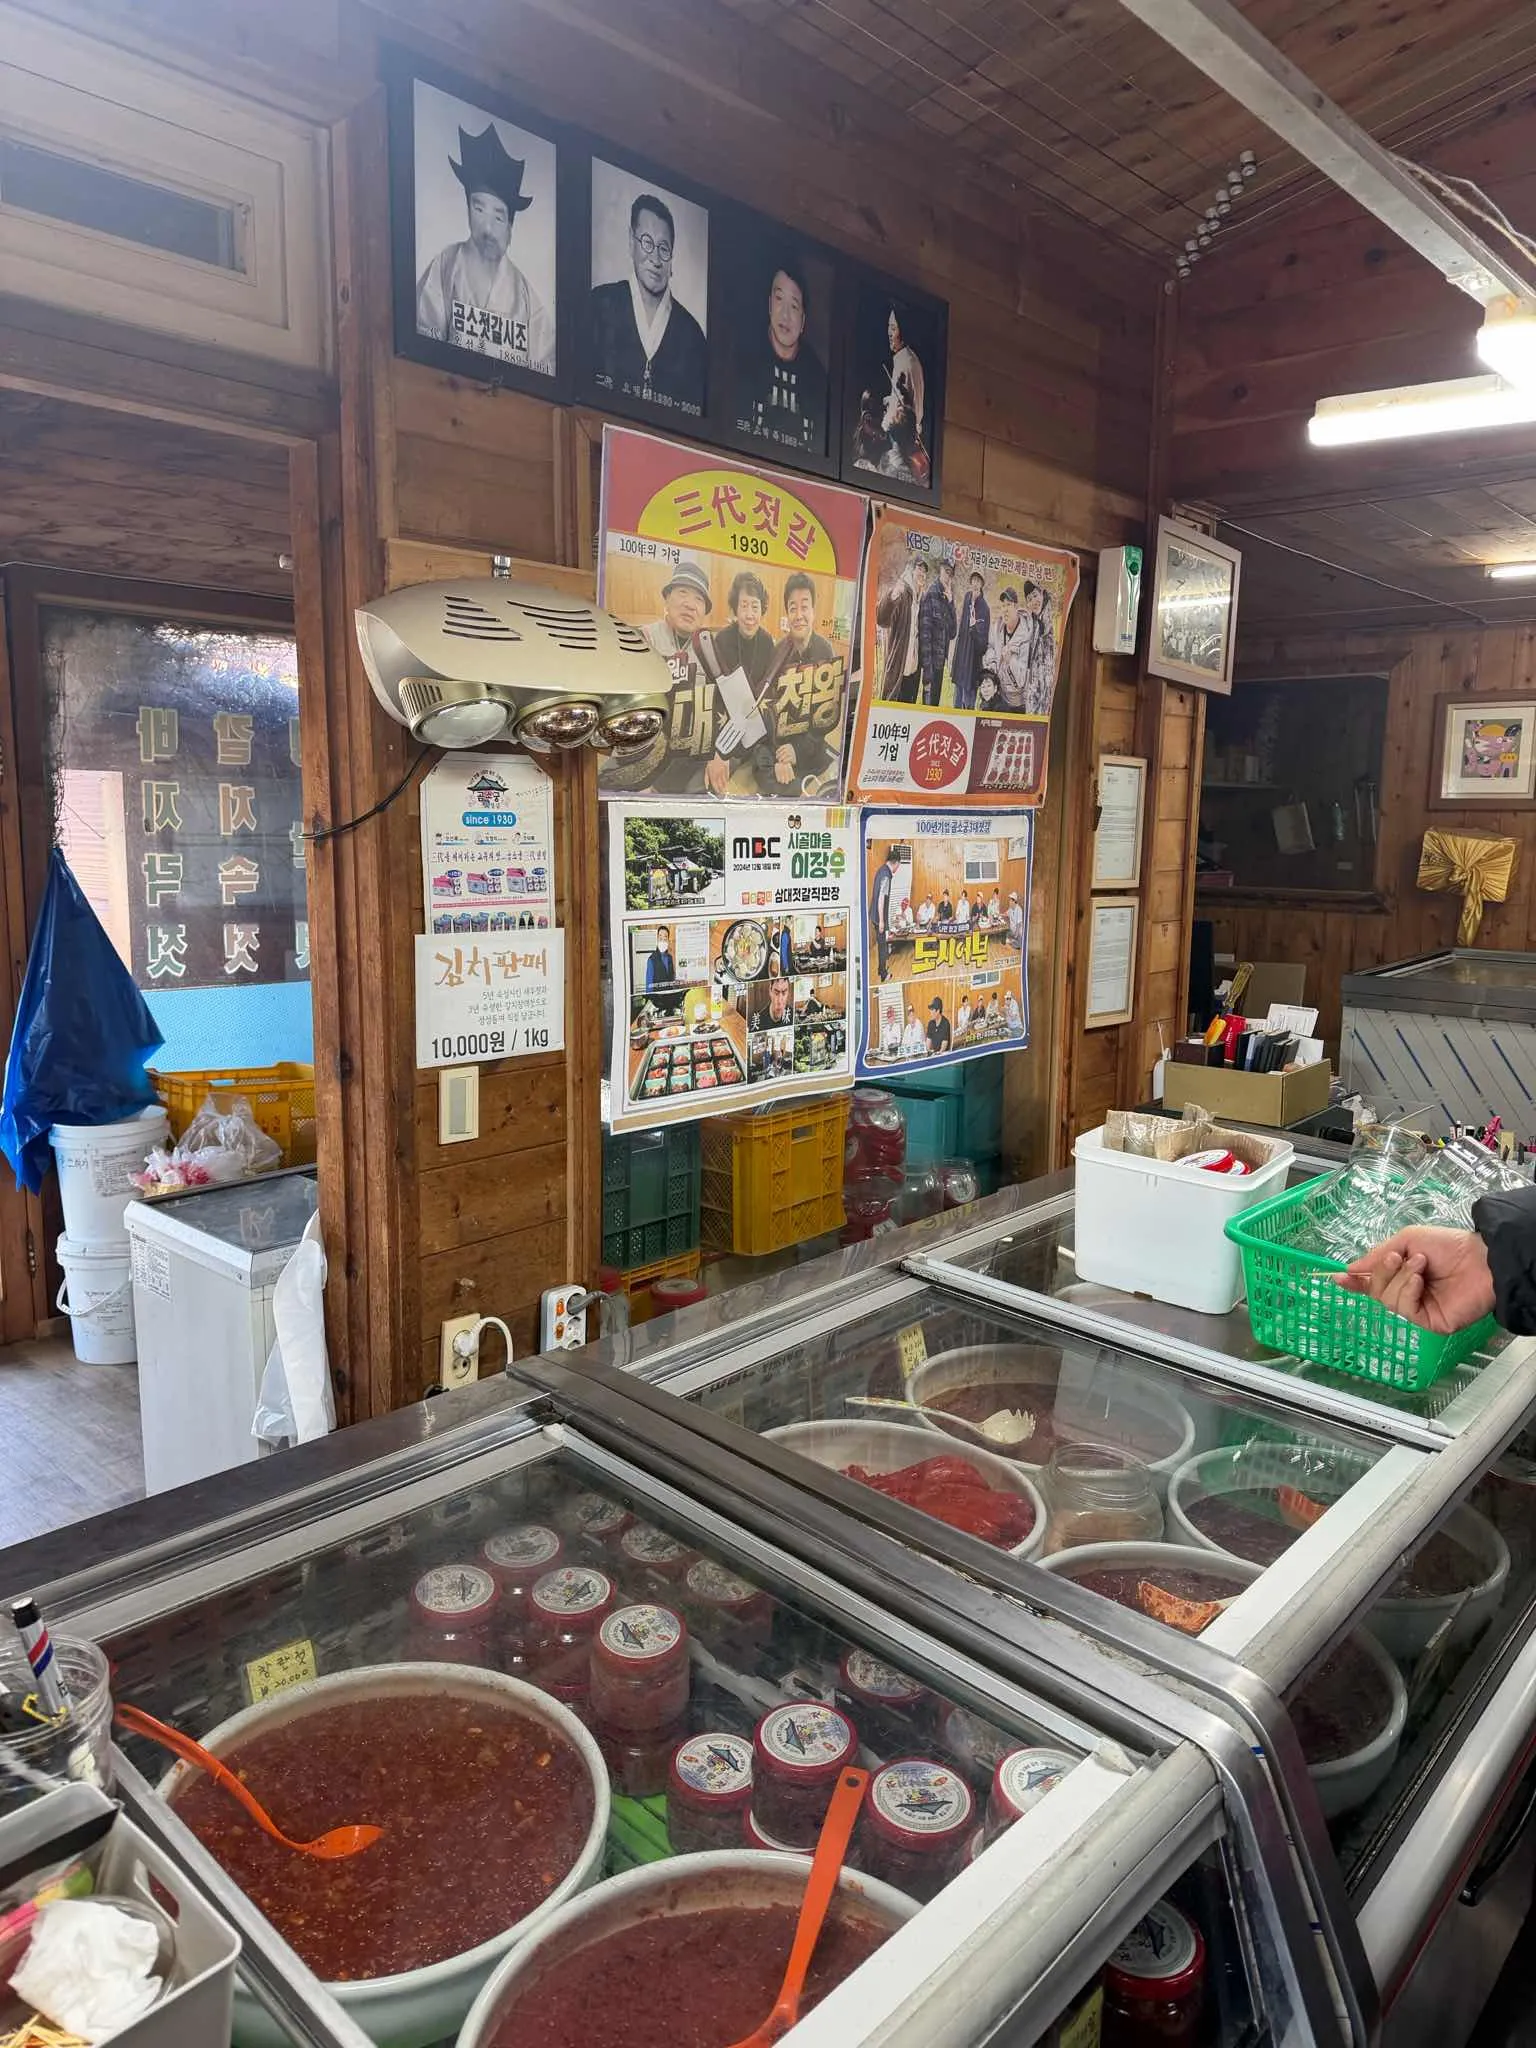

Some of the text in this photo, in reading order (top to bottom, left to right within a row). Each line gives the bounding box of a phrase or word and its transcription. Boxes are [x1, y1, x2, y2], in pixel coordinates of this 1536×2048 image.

[454, 302, 528, 352] 곰소젓갈시조
[673, 485, 815, 561] 三代젓갈
[619, 537, 681, 565] 100年의 기업
[730, 533, 769, 557] 1930
[906, 530, 930, 552] KBS
[775, 656, 845, 738] 천왕
[871, 723, 911, 743] 100年의
[878, 743, 898, 762] 기업
[915, 733, 967, 767] 三代젓갈
[925, 768, 943, 782] 1930
[465, 814, 513, 825] since 1930
[733, 837, 781, 859] MBC
[788, 832, 832, 850] 시골마을
[733, 863, 750, 871] 2024년
[791, 849, 846, 879] 이장우
[774, 886, 840, 904] 삼대젓갈직판장
[911, 930, 989, 975] 도시어부
[482, 991, 494, 1001] 5년
[432, 1027, 549, 1059] 10,000원 / 1kg
